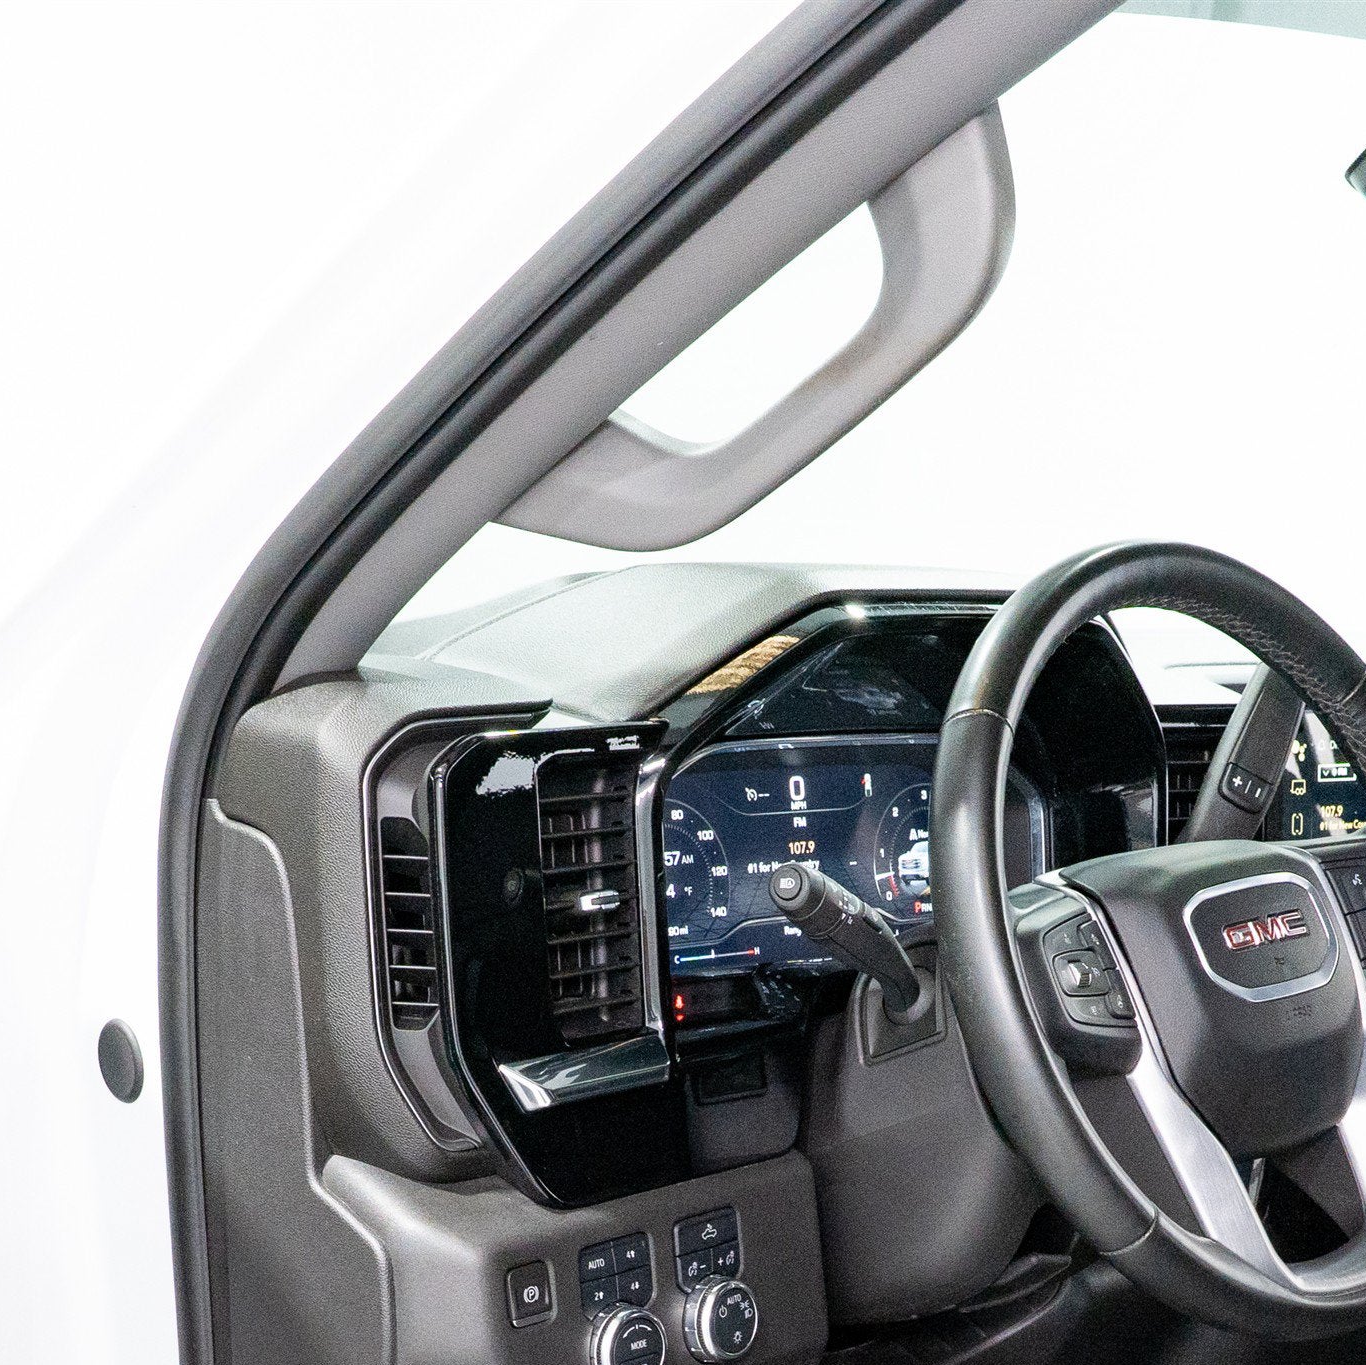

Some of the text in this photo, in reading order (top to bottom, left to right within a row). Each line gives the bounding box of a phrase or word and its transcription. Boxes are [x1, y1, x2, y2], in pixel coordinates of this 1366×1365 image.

[789, 775, 805, 800] 0
[921, 789, 927, 800] 3
[790, 801, 807, 810] MPH
[892, 806, 899, 817] 2
[1320, 805, 1343, 818] 107.9
[793, 817, 807, 828] FM
[697, 829, 714, 840] 100
[788, 840, 815, 855] 107.9
[681, 855, 694, 865] AM
[711, 865, 728, 877] 120
[758, 861, 771, 873] for
[886, 890, 893, 901] 0
[710, 906, 727, 917] 140
[1222, 907, 1308, 951] GMC
[588, 1258, 605, 1270] AUTO
[727, 1294, 742, 1305] AUTO
[630, 1339, 648, 1350] MODE
